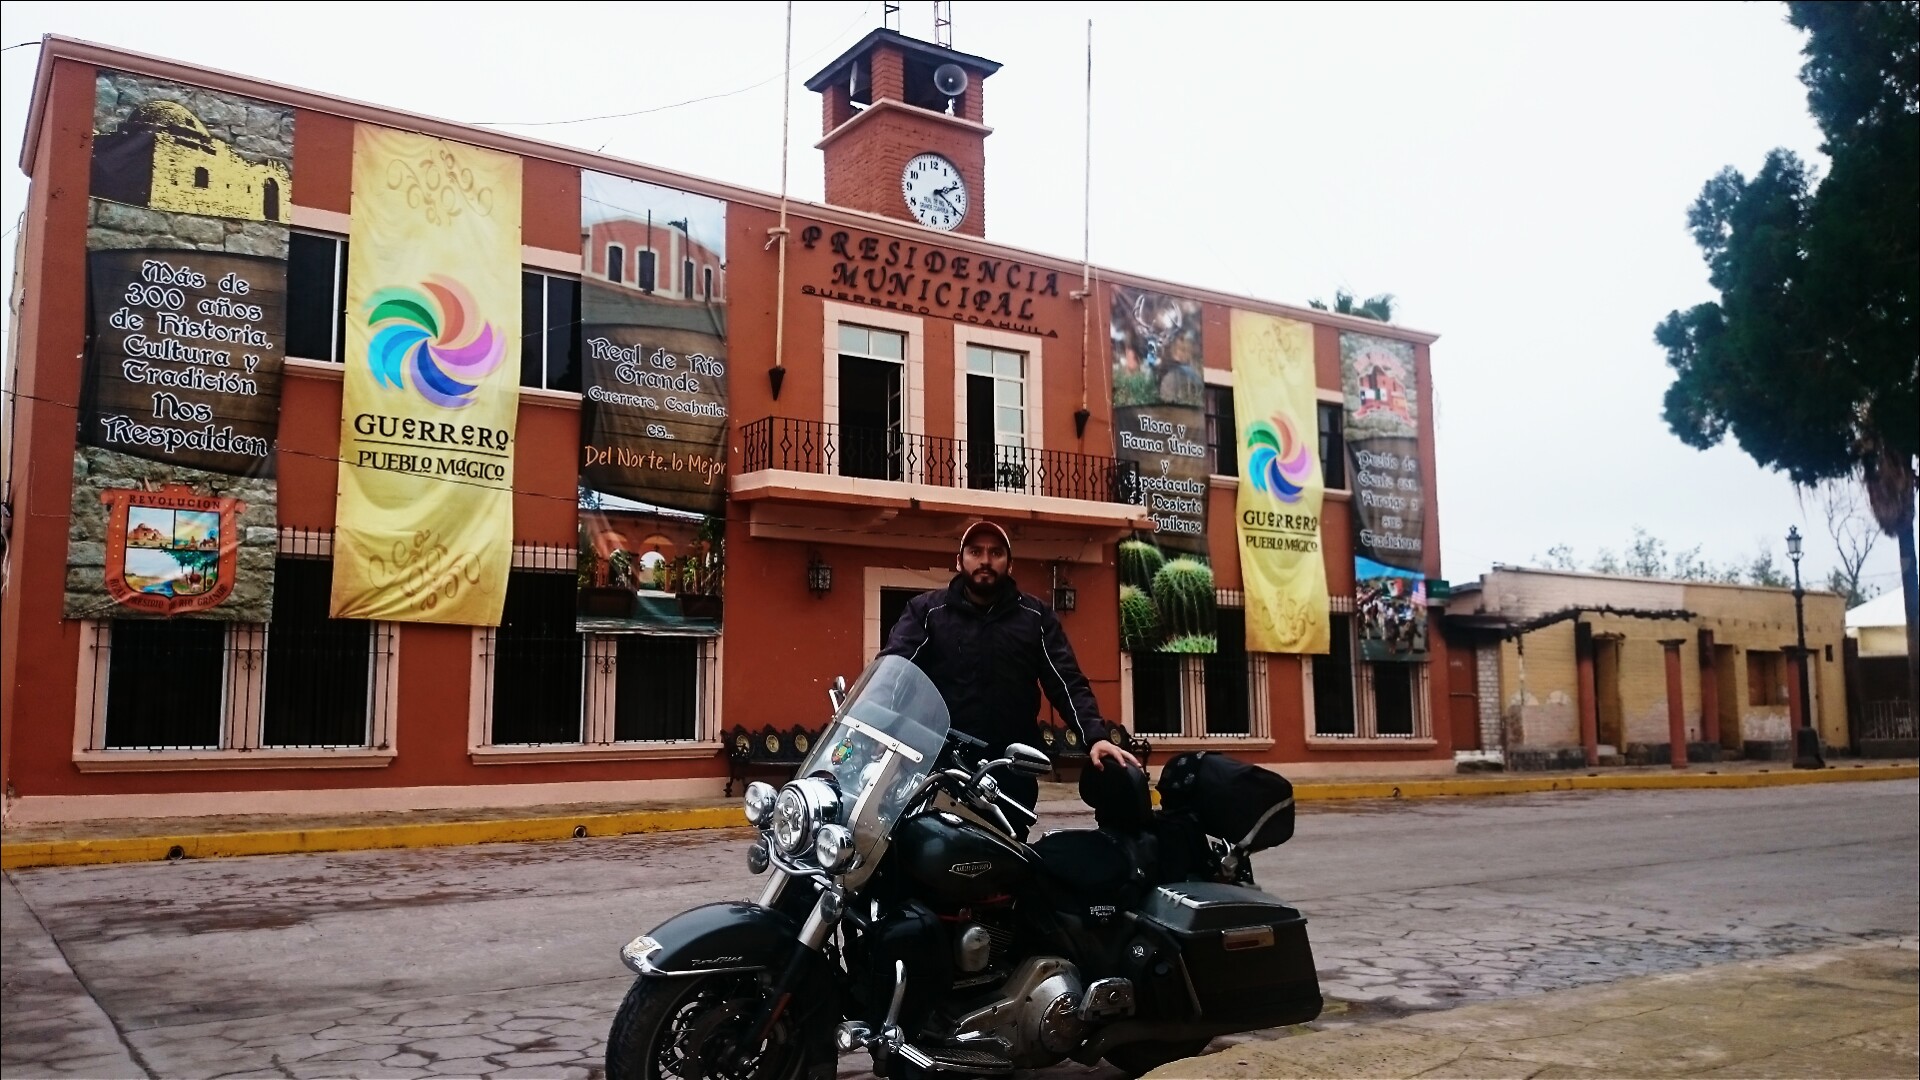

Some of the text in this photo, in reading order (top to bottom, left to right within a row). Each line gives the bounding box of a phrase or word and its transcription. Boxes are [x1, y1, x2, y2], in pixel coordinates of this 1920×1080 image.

[910, 170, 919, 180] 10
[918, 161, 926, 171] 11
[930, 160, 939, 171] 12
[906, 181, 913, 191] 9
[909, 196, 917, 206] 8
[955, 194, 961, 203] 3
[919, 208, 926, 218] 7
[930, 215, 937, 225] 6
[943, 215, 950, 224] 5
[801, 225, 1060, 297] PRESIDENCIA
[142, 259, 249, 295] Más de
[831, 262, 1035, 320] MUNICIPAL
[125, 283, 262, 321] 300 años
[801, 284, 1058, 338] GUERRERO COAHUILA
[110, 307, 273, 349] de Historia,
[124, 334, 259, 374] Cultura y
[587, 337, 724, 378] Real de Río
[123, 359, 257, 396] Tradición
[615, 362, 699, 394] Grande
[152, 392, 212, 422] Nos
[101, 415, 268, 457] Respaldan
[647, 424, 674, 439] es...
[1138, 414, 1185, 438] Flora y
[1120, 431, 1163, 452] Fauna
[584, 445, 612, 467] Del
[672, 452, 684, 471] lo
[689, 454, 727, 485] Mejor
[1161, 460, 1169, 475] y
[1139, 476, 1205, 495] pectacular
[129, 494, 220, 510] REVOLUCION
[1152, 494, 1202, 514] Desierto
